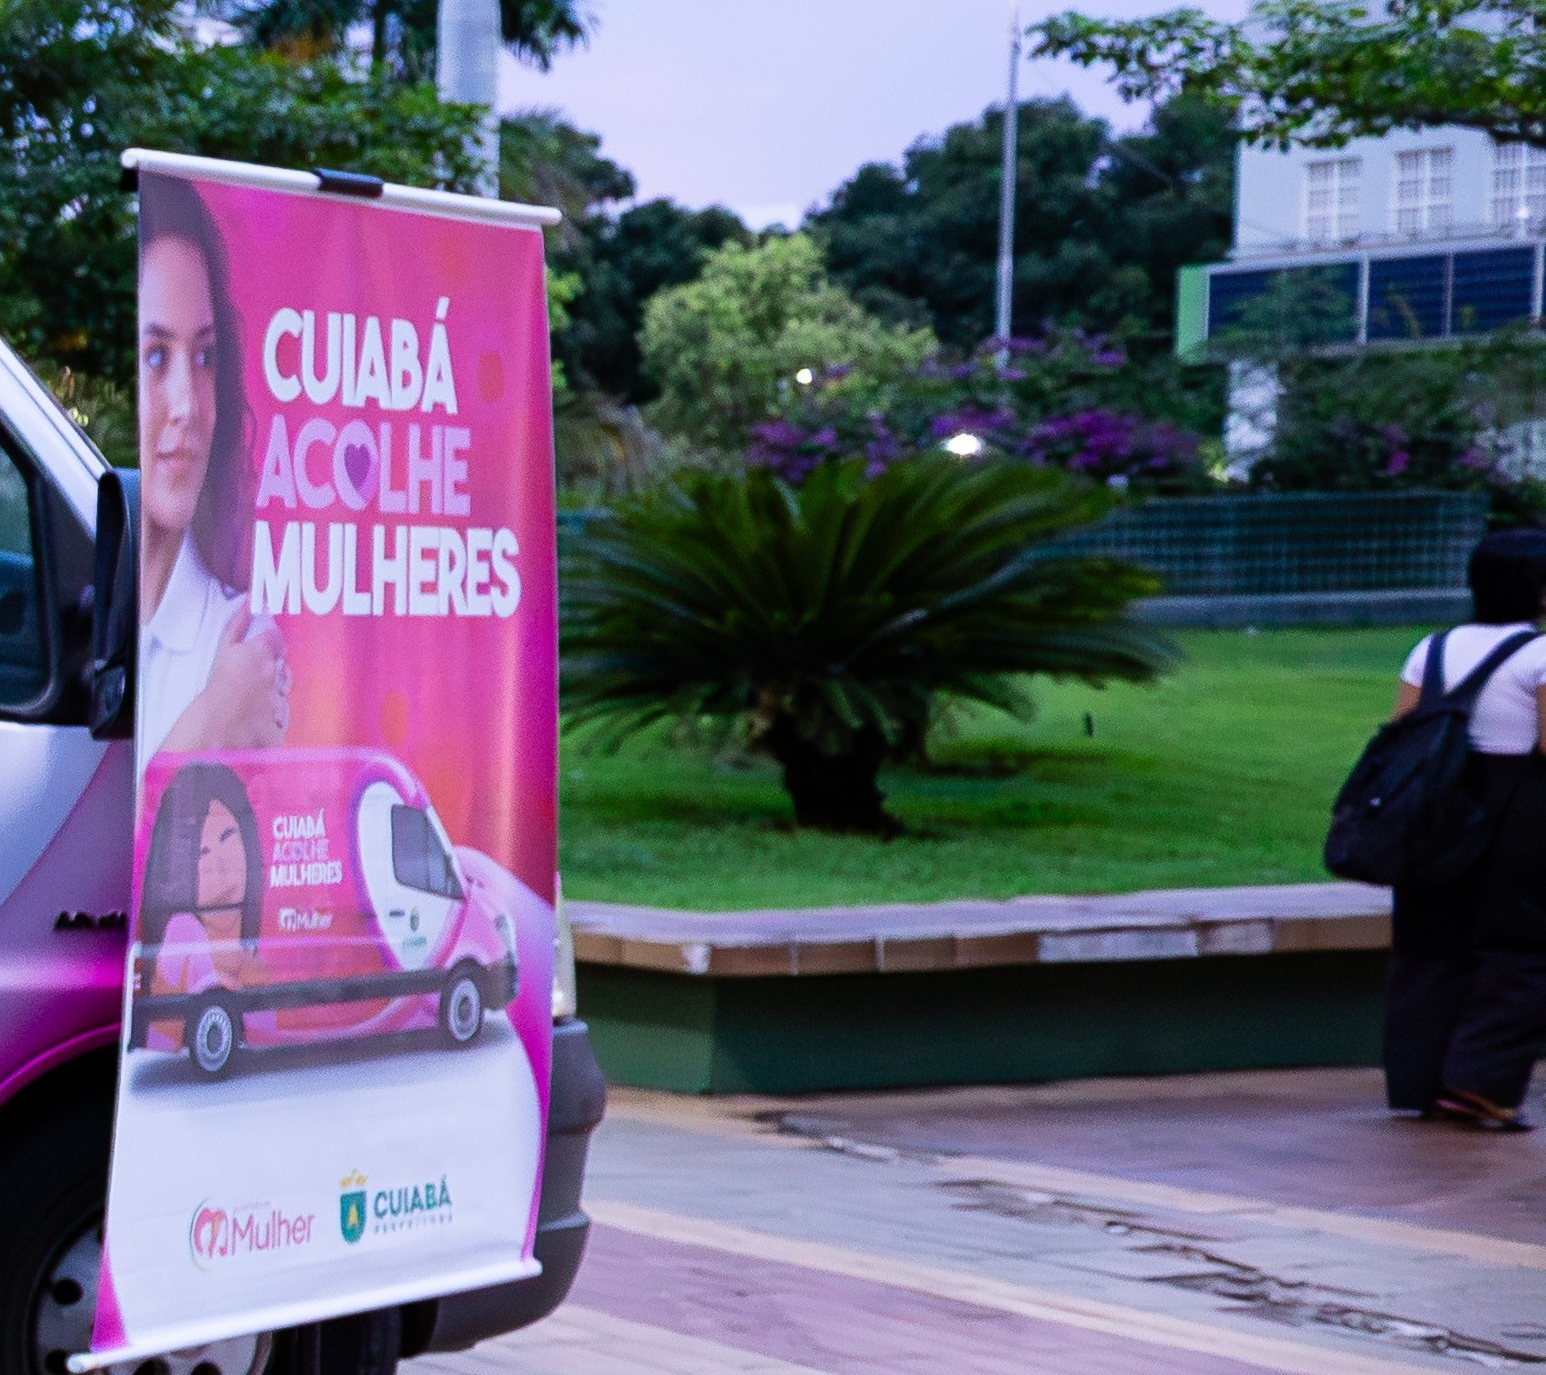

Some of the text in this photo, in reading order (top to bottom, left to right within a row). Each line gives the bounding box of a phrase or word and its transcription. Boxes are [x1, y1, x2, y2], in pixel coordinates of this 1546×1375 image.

[264, 295, 458, 415] CUIABÁ
[256, 414, 472, 517] ACOLHE
[250, 520, 521, 619] MULHERES
[232, 1209, 315, 1256] Mulher
[373, 1174, 452, 1219] CUIABÁ
